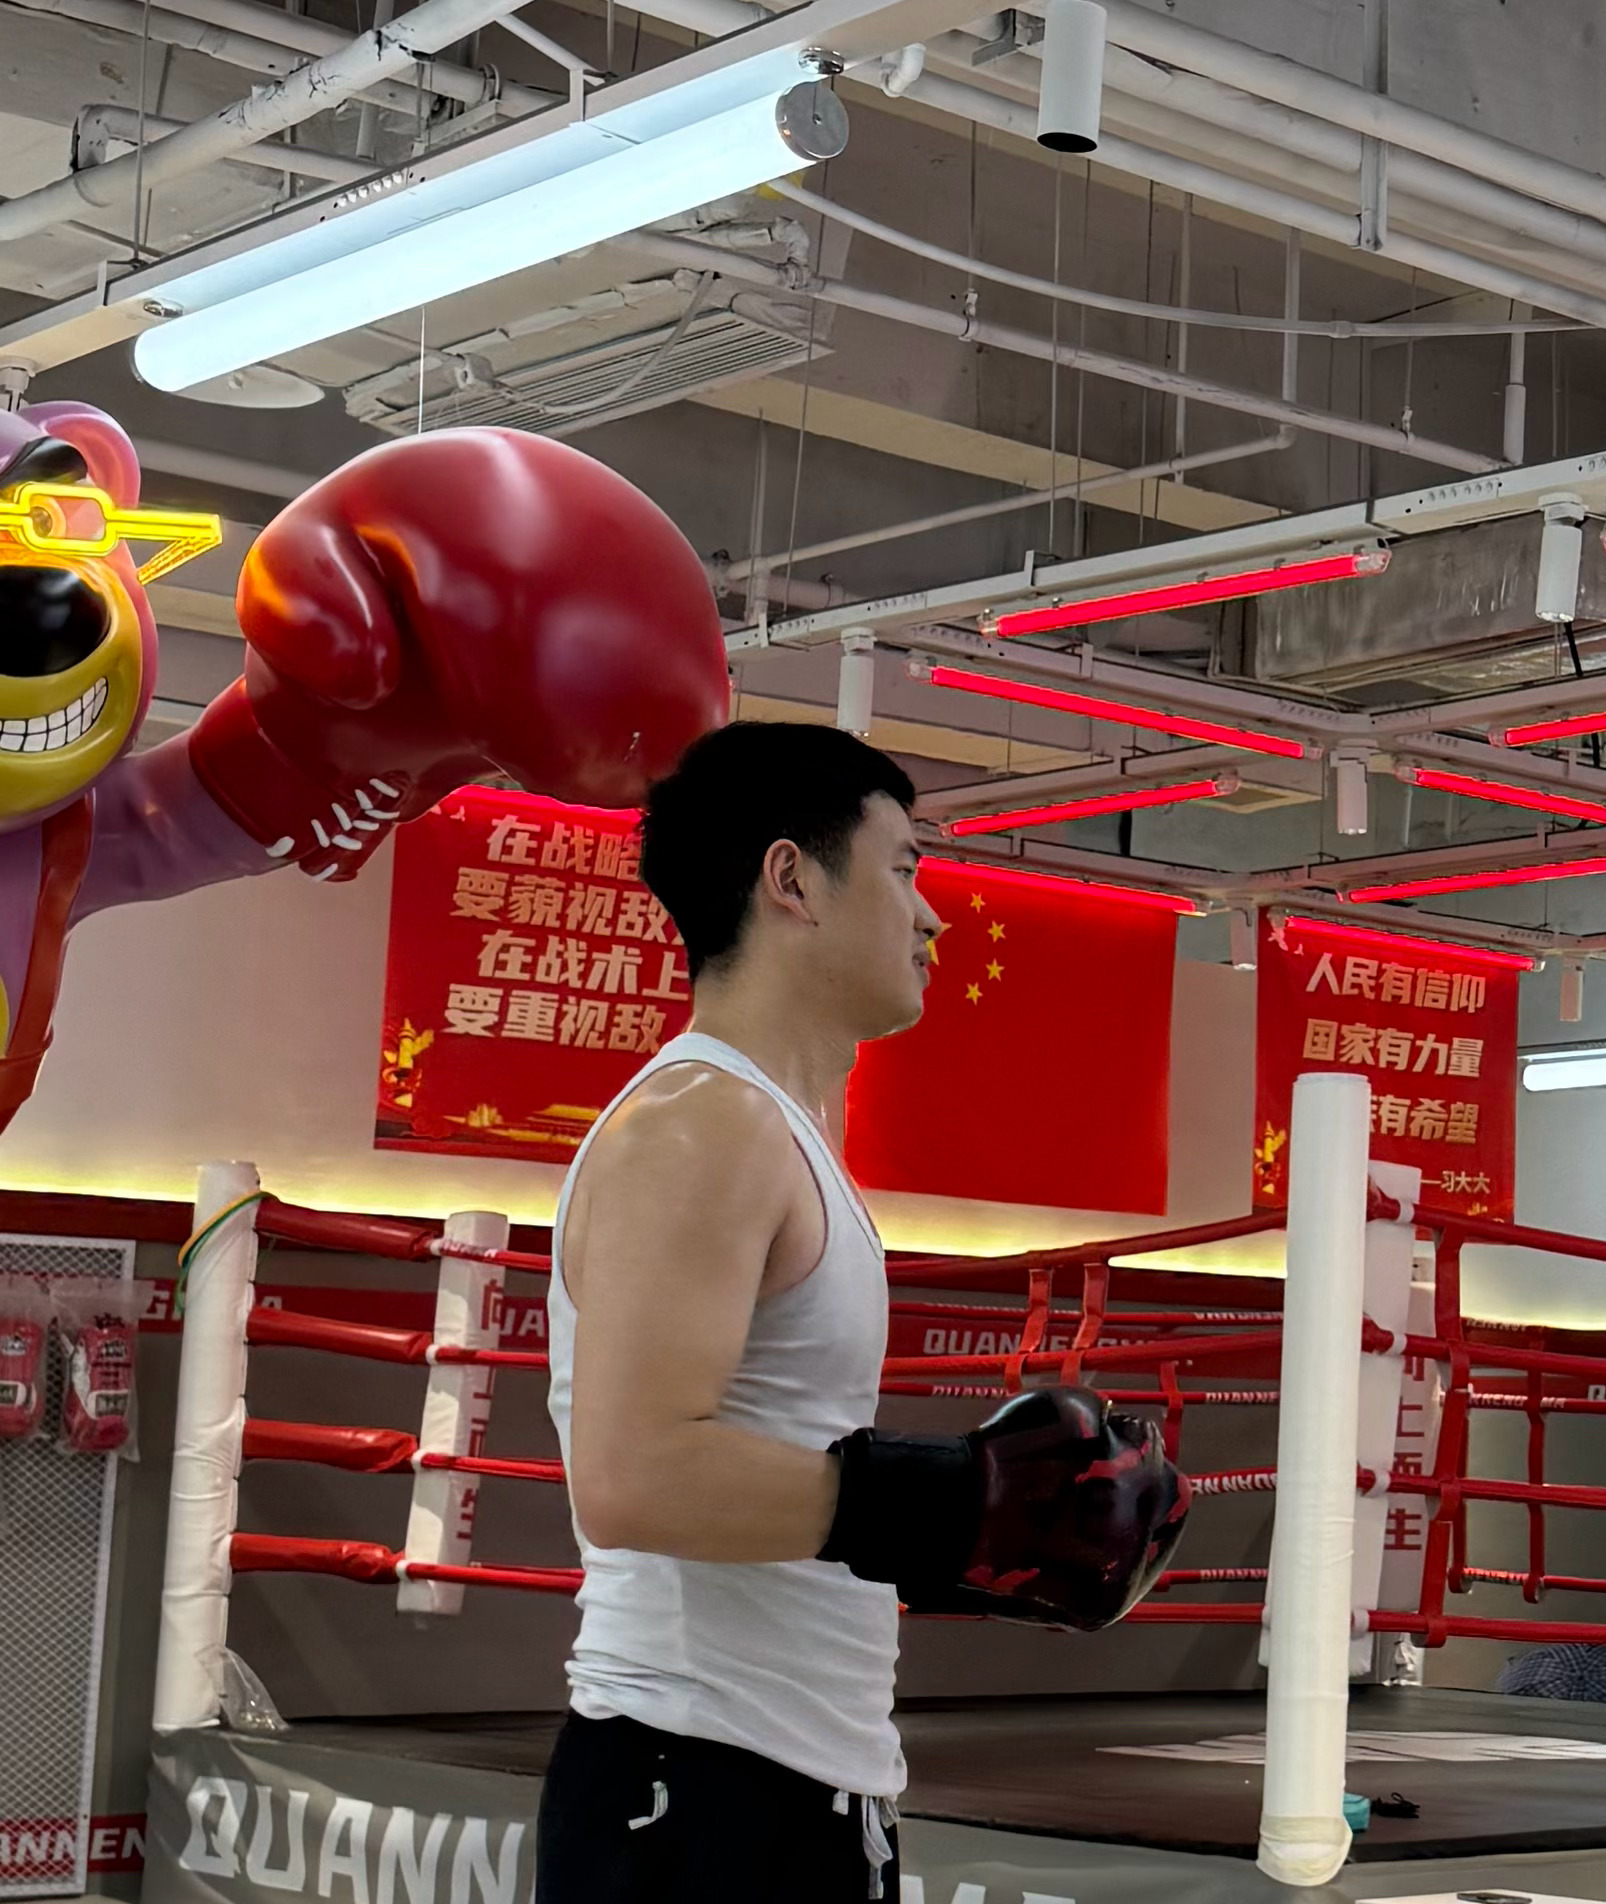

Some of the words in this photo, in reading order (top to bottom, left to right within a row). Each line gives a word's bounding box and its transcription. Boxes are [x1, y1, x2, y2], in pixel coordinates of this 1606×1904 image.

[450, 867, 686, 946] 要藐视敌
[477, 929, 690, 1001] 在战术上
[1306, 953, 1486, 1013] 人民有信仰
[1303, 1018, 1484, 1078] 国家有力量
